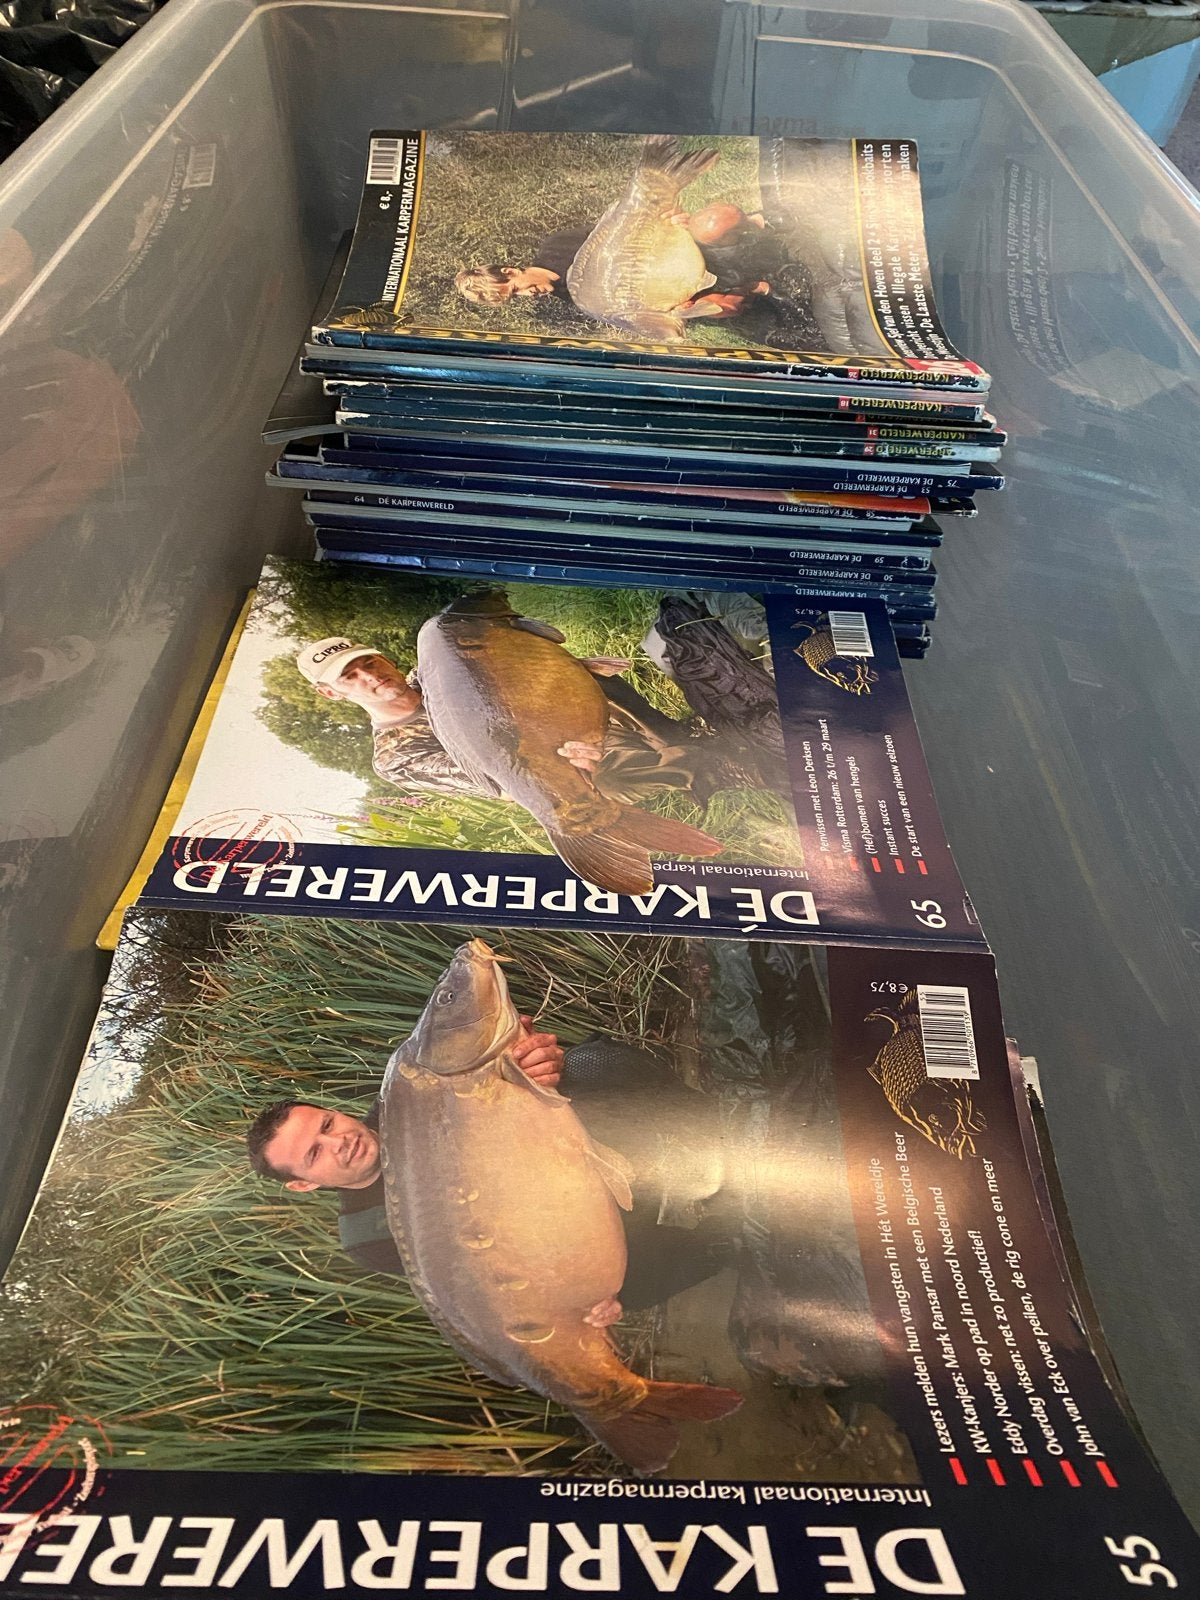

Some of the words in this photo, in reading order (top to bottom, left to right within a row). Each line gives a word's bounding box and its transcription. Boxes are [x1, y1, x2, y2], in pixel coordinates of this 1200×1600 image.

[860, 144, 875, 196] Hookbaits
[896, 144, 911, 181] maken
[381, 234, 408, 302] INTERNATIONAAL
[396, 138, 419, 234] KARPERMAGAZINE
[868, 247, 883, 267] deel
[908, 250, 922, 281] Meter
[873, 270, 888, 298] Hoven
[888, 255, 907, 294] Illegale
[877, 299, 892, 315] den
[913, 284, 931, 316] Laatste
[883, 315, 896, 327] van
[900, 305, 915, 329] vissen
[920, 318, 934, 329] De
[884, 326, 904, 340] Sjef
[848, 371, 858, 379] 26
[840, 400, 849, 408] 18
[851, 397, 943, 413] KARPERWERELD
[879, 428, 965, 441] KARPERWERELD
[833, 482, 896, 494] KARPERWERELD
[857, 473, 920, 485] KARPERWERELD
[921, 486, 931, 494] 53
[354, 495, 365, 503] 64
[391, 498, 455, 510] KARPERWERELD
[778, 504, 841, 517] KARPERWERELD
[789, 551, 850, 563] KARPERWERELD
[874, 556, 885, 564] 59
[798, 568, 859, 580] KARPERWERELD
[883, 574, 894, 582] 50
[817, 718, 831, 741] maart
[801, 740, 815, 772] Derksen
[821, 741, 833, 753] 29
[882, 733, 898, 764] seizoen
[824, 753, 836, 769] t/m
[844, 755, 861, 787] hengels
[807, 773, 819, 794] Leon
[826, 768, 838, 781] 26
[890, 763, 905, 790] nieuw
[811, 794, 823, 811] met
[829, 781, 846, 828] Rotterdam:
[853, 788, 865, 804] van
[897, 790, 908, 807] een
[877, 799, 891, 827] succes
[901, 807, 912, 824] van
[815, 813, 830, 853] Penvissen
[839, 829, 853, 854] Visma
[857, 805, 879, 855] (Hef)bomen
[884, 827, 899, 856] Instant
[904, 824, 919, 845] start
[910, 845, 923, 858] De
[702, 861, 809, 881] Internationaal
[172, 860, 712, 919] KARPERWERELD
[730, 886, 821, 933] DÉ
[911, 899, 947, 929] 65
[870, 981, 909, 994] €8,75
[893, 1131, 908, 1162] Beer
[868, 1157, 888, 1217] Wereldje
[981, 1157, 999, 1193] meer
[899, 1165, 919, 1226] Belgische
[990, 1195, 1004, 1213] en
[877, 1218, 894, 1243] Hét
[928, 1186, 957, 1256] Nederland
[996, 1215, 1014, 1247] cone
[883, 1246, 898, 1259] in
[911, 1229, 926, 1254] een
[917, 1256, 934, 1284] met
[967, 1229, 1005, 1302] productief!
[1004, 1250, 1022, 1269] rig
[944, 1259, 969, 1299] noord
[1011, 1271, 1027, 1289] de
[888, 1262, 913, 1323] vangsten
[925, 1286, 947, 1330] Pansar
[958, 1302, 974, 1316] in
[992, 1305, 1007, 1322] zo
[1020, 1292, 1049, 1336] peilen,
[903, 1326, 921, 1353] hun
[962, 1318, 989, 1344] pad
[997, 1324, 1018, 1347] net
[935, 1333, 960, 1368] Mark
[975, 1347, 993, 1366] op
[1037, 1338, 1058, 1369] over
[912, 1355, 939, 1407] melden
[1008, 1349, 1036, 1394] vissen:
[1048, 1370, 1071, 1394] Eck
[981, 1368, 1012, 1417] Norder
[951, 1372, 992, 1454] KW-Kanjers:
[1064, 1397, 1083, 1422] van
[928, 1409, 956, 1453] Lezers
[1002, 1420, 1029, 1454] Eddy
[1026, 1396, 1064, 1456] Overdag
[1076, 1424, 1105, 1457] John
[541, 1479, 746, 1506] karpermagazine
[754, 1483, 932, 1508] Internationaal
[1103, 1535, 1179, 1589] 55
